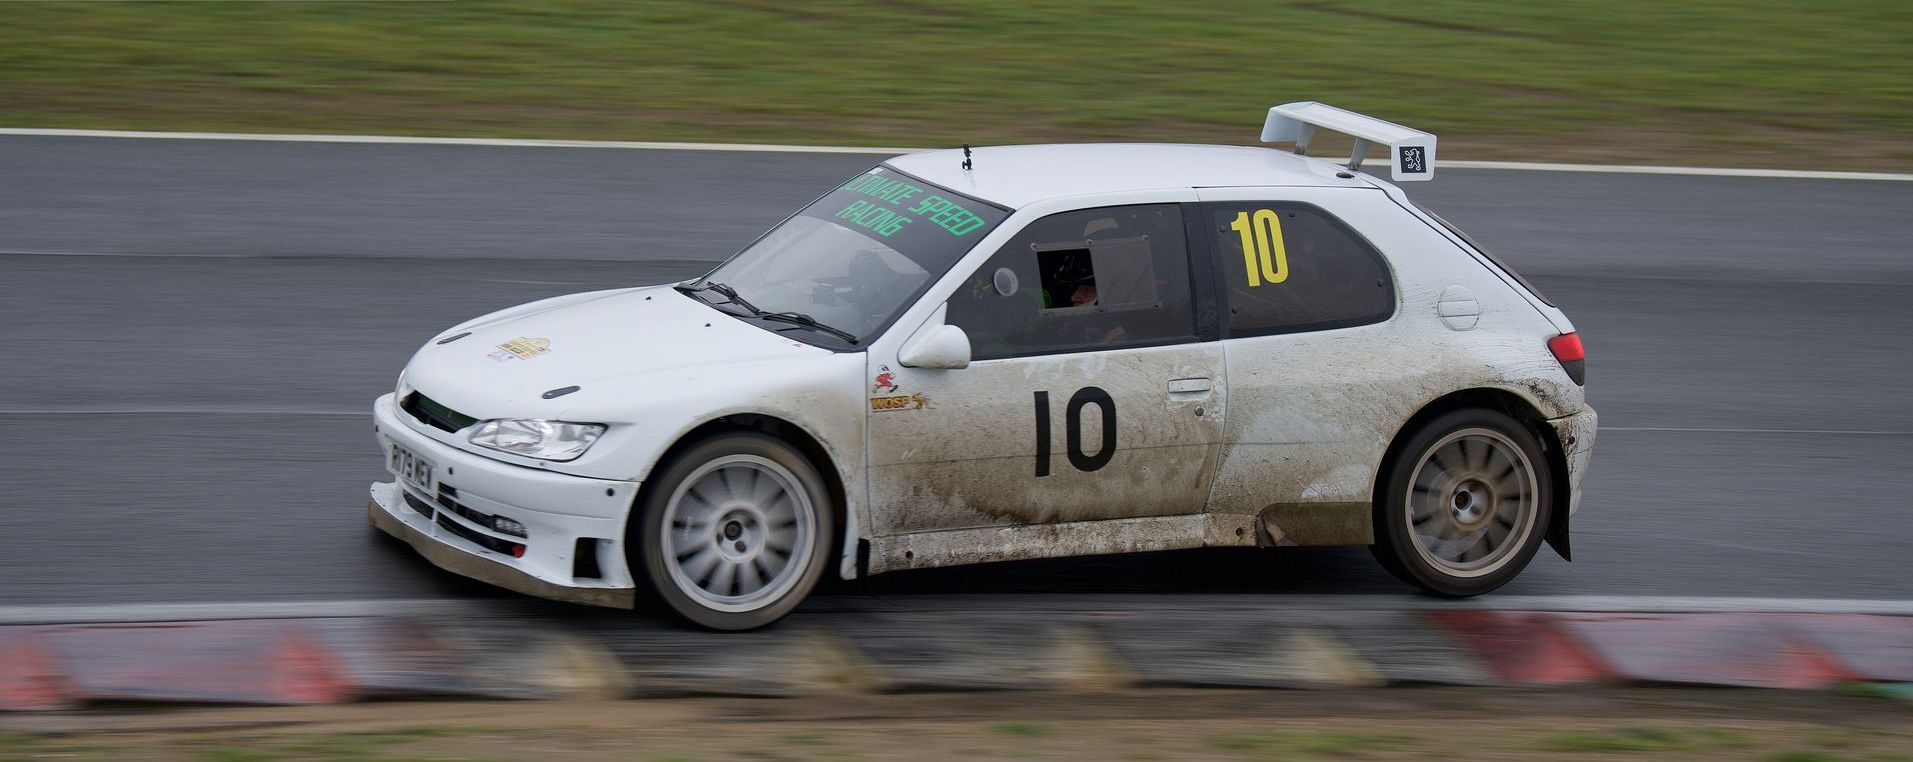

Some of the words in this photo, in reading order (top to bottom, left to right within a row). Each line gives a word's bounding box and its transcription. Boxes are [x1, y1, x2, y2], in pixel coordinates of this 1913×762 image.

[835, 200, 913, 237] RACING
[907, 195, 986, 236] SPEED
[1231, 208, 1289, 287] 10
[1033, 386, 1117, 478] 10
